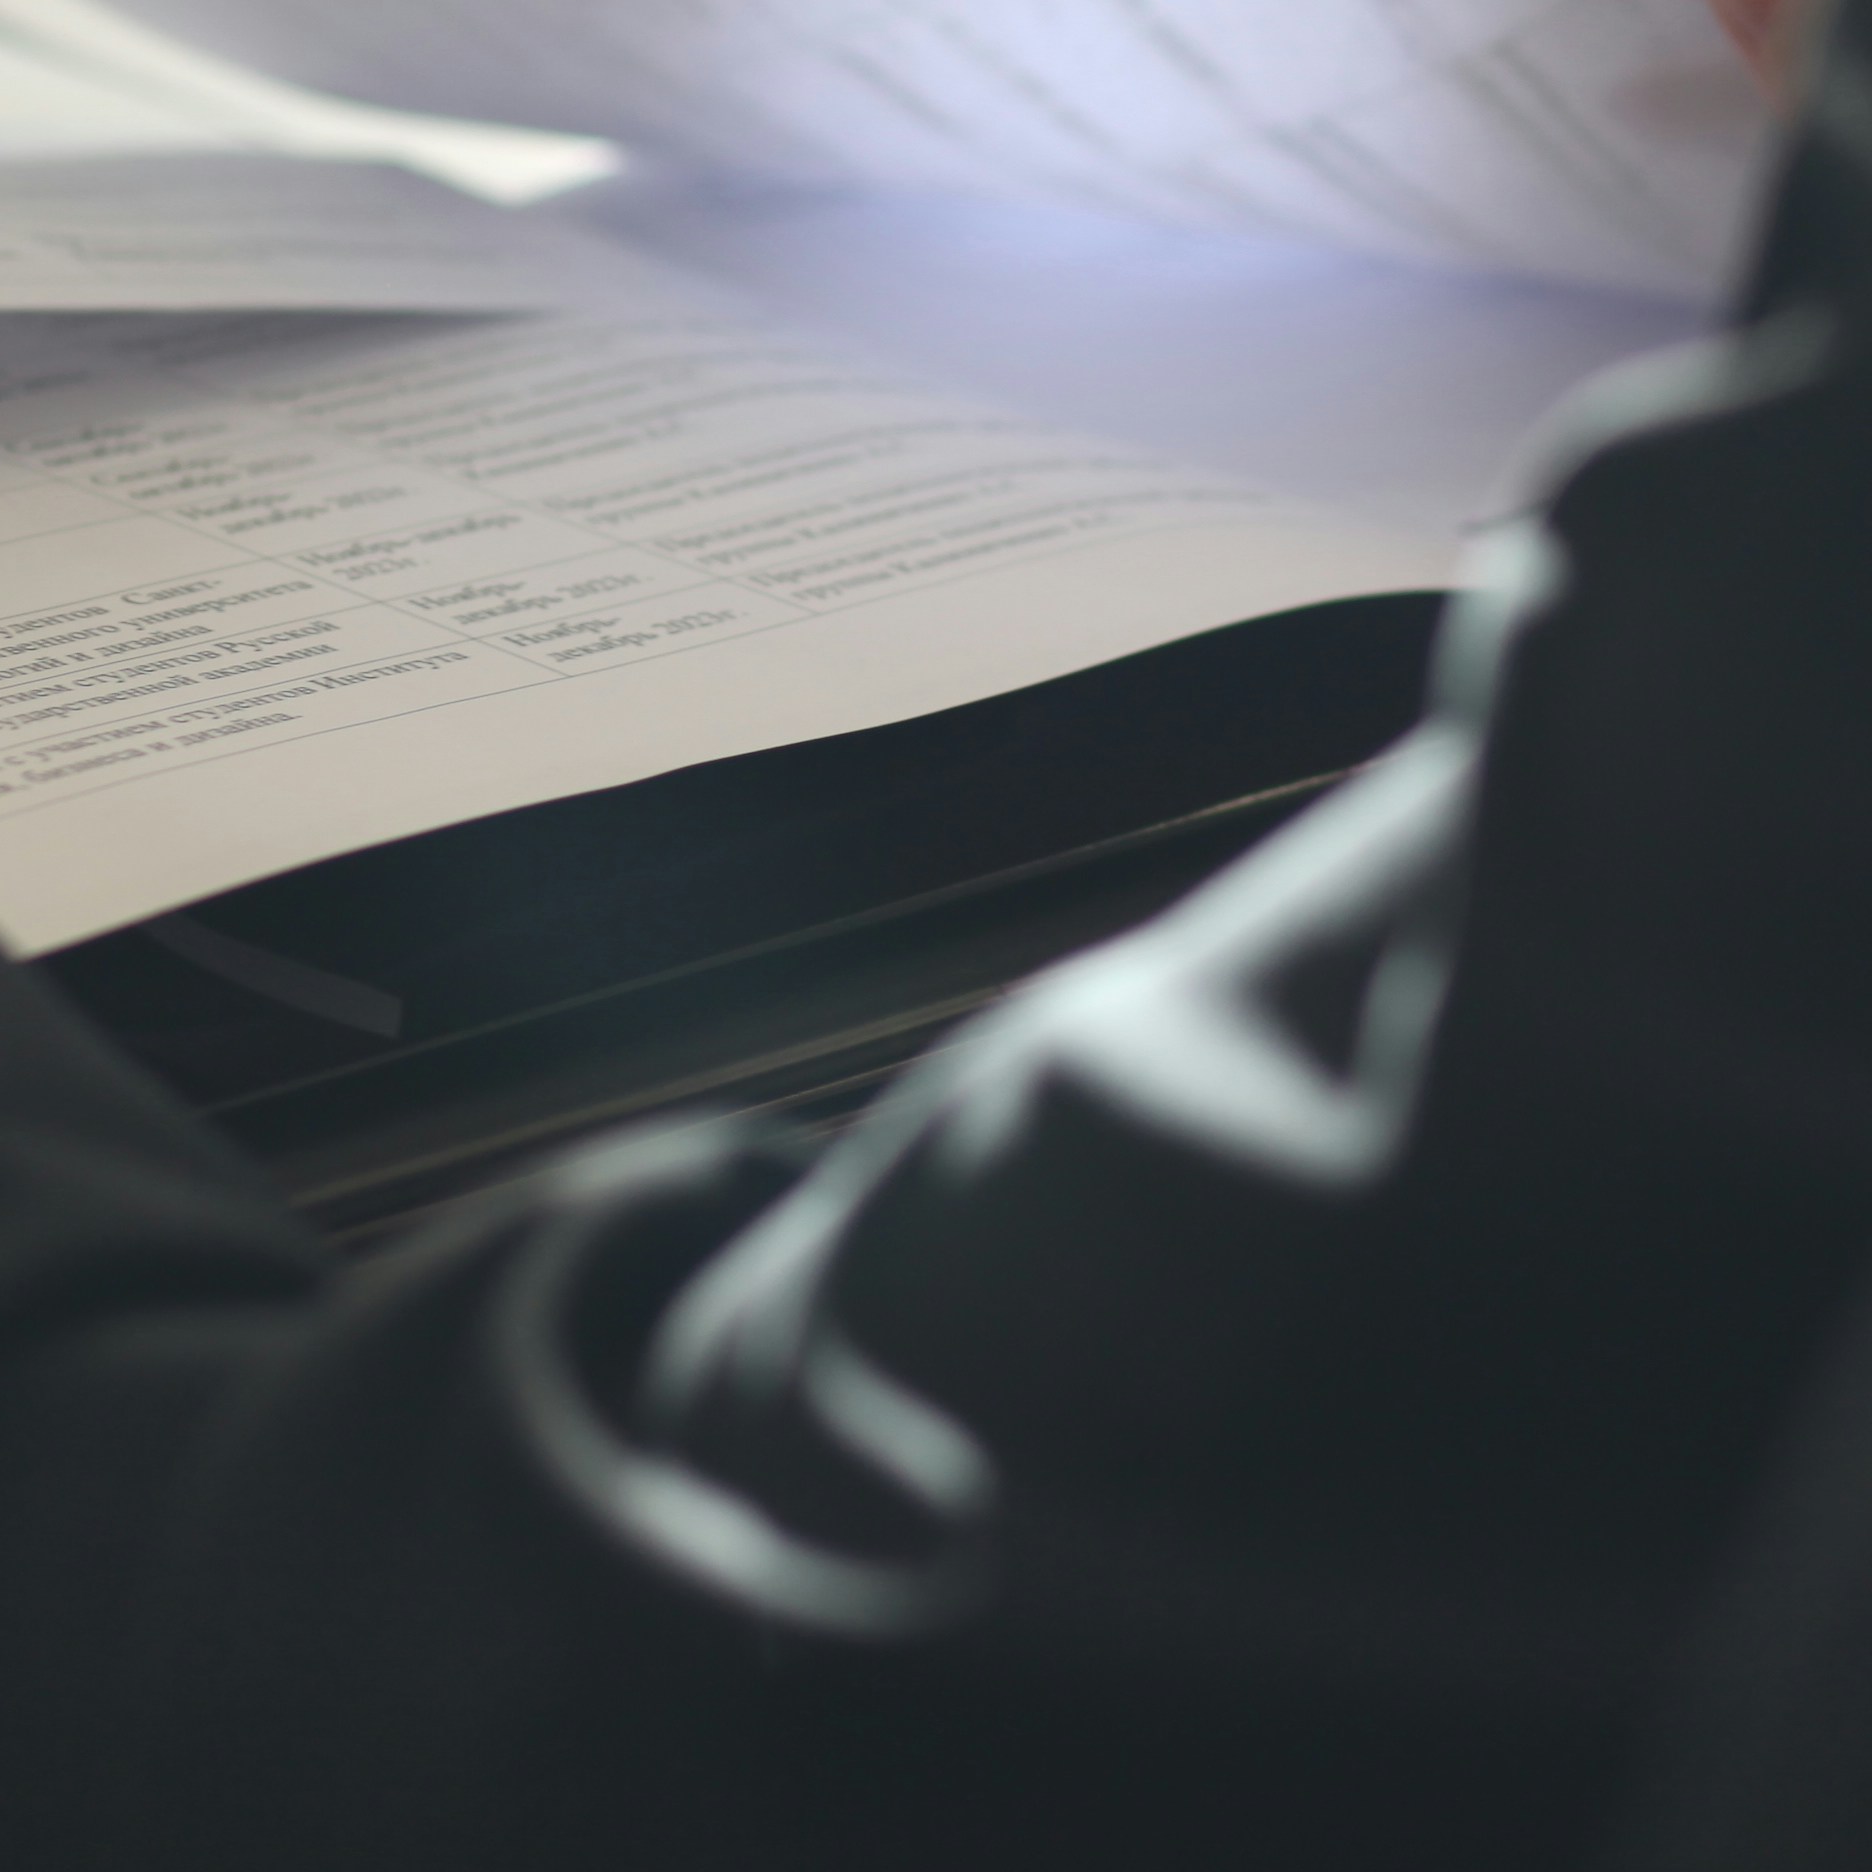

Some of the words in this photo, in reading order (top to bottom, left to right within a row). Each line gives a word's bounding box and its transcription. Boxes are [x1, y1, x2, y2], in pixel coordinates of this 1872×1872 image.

[119, 579, 224, 605] Санкт-
[119, 579, 315, 630] университета
[66, 651, 94, 663] и
[94, 624, 214, 658] дизайна
[501, 617, 622, 647] Ноябрь-
[546, 631, 660, 663] декабрь
[72, 649, 221, 688] студентов
[213, 619, 342, 654] Русской
[197, 643, 340, 680] академии
[2, 754, 26, 766] с
[24, 719, 169, 763] участием
[167, 684, 317, 721] студентов
[309, 649, 469, 691] Института
[146, 740, 174, 753] и
[174, 712, 304, 747] дизайна.
